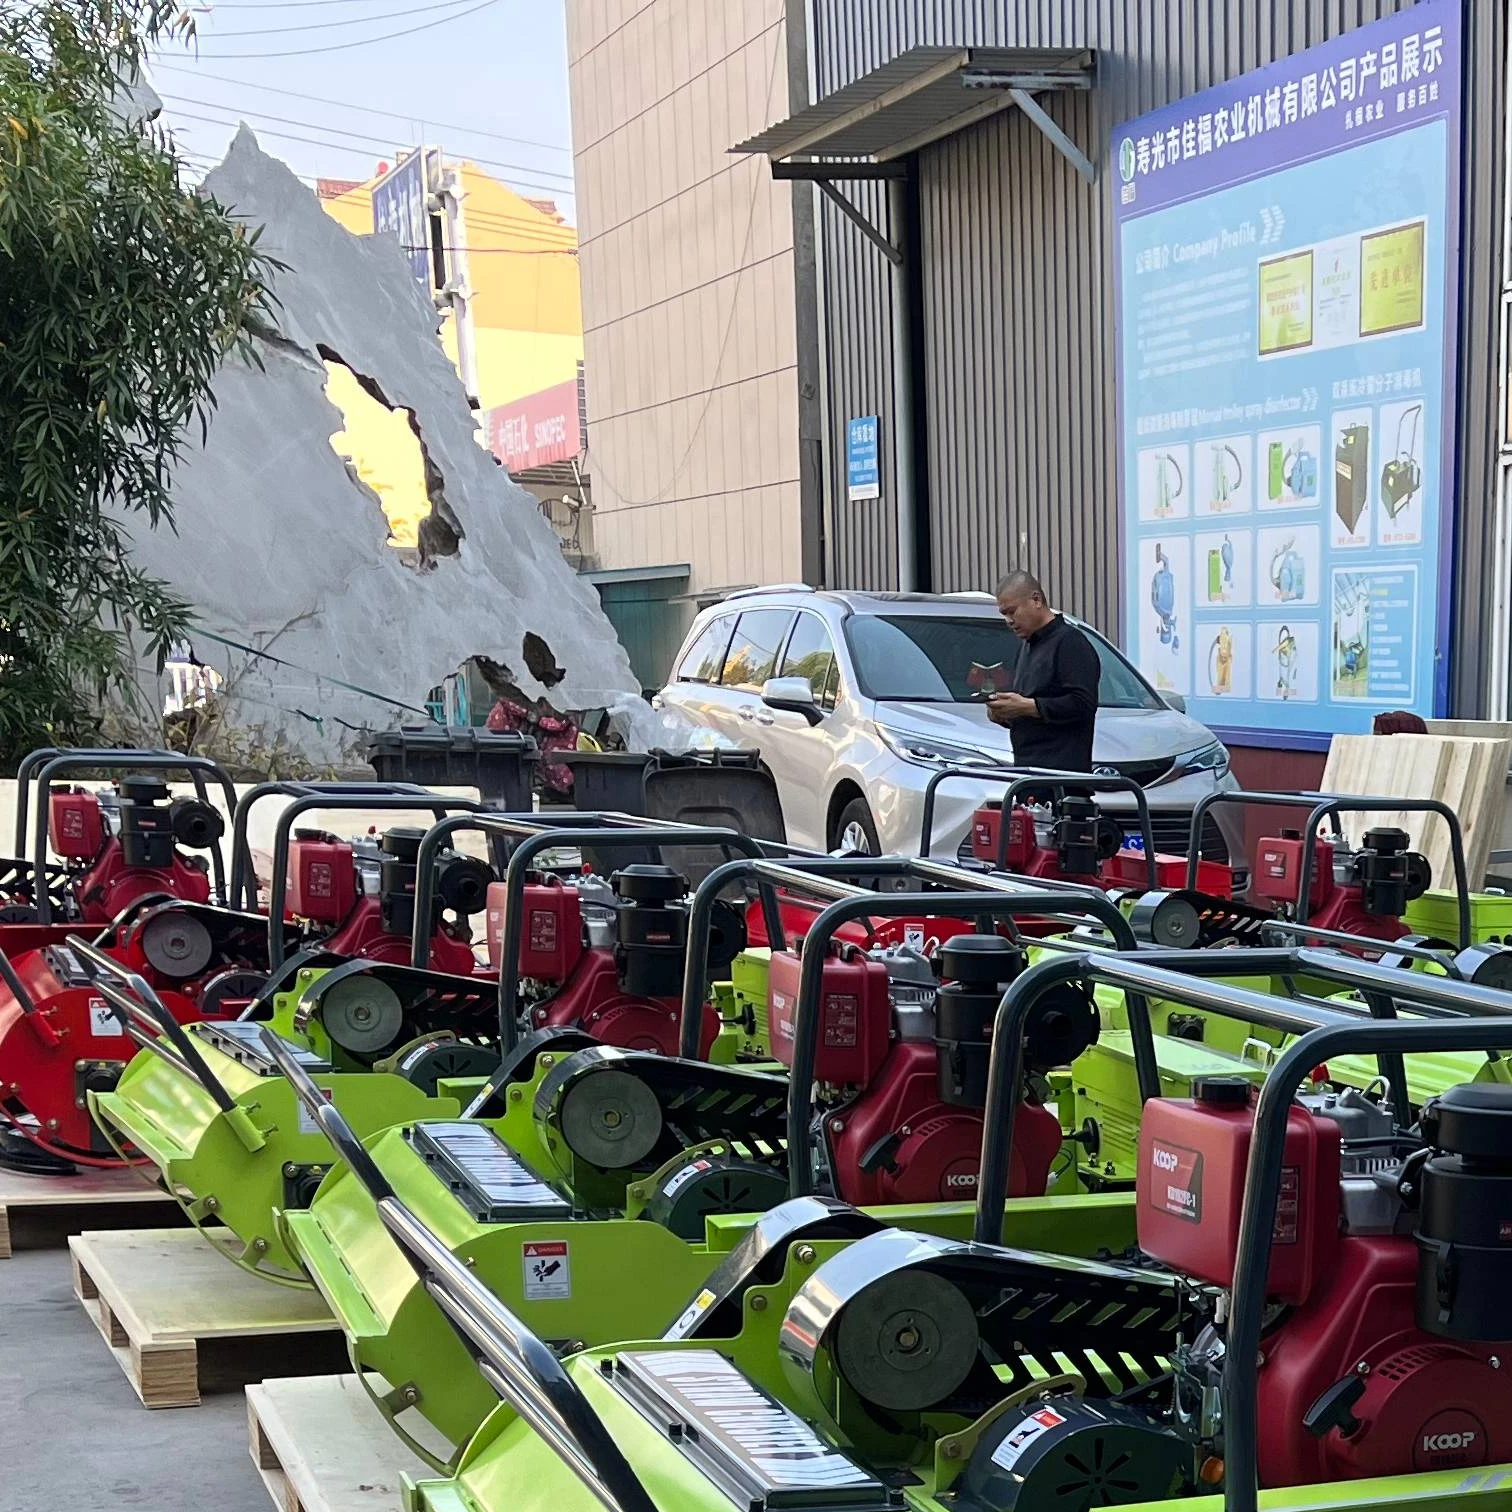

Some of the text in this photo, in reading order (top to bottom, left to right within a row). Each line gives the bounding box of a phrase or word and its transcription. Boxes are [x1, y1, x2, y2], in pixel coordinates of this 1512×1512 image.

[1136, 25, 1443, 175] 寿光市佳福农业机械有限公司产品展示
[534, 414, 566, 449] SINOPEC
[1153, 1147, 1178, 1172] KOOP
[1423, 1431, 1476, 1452] KOOP
